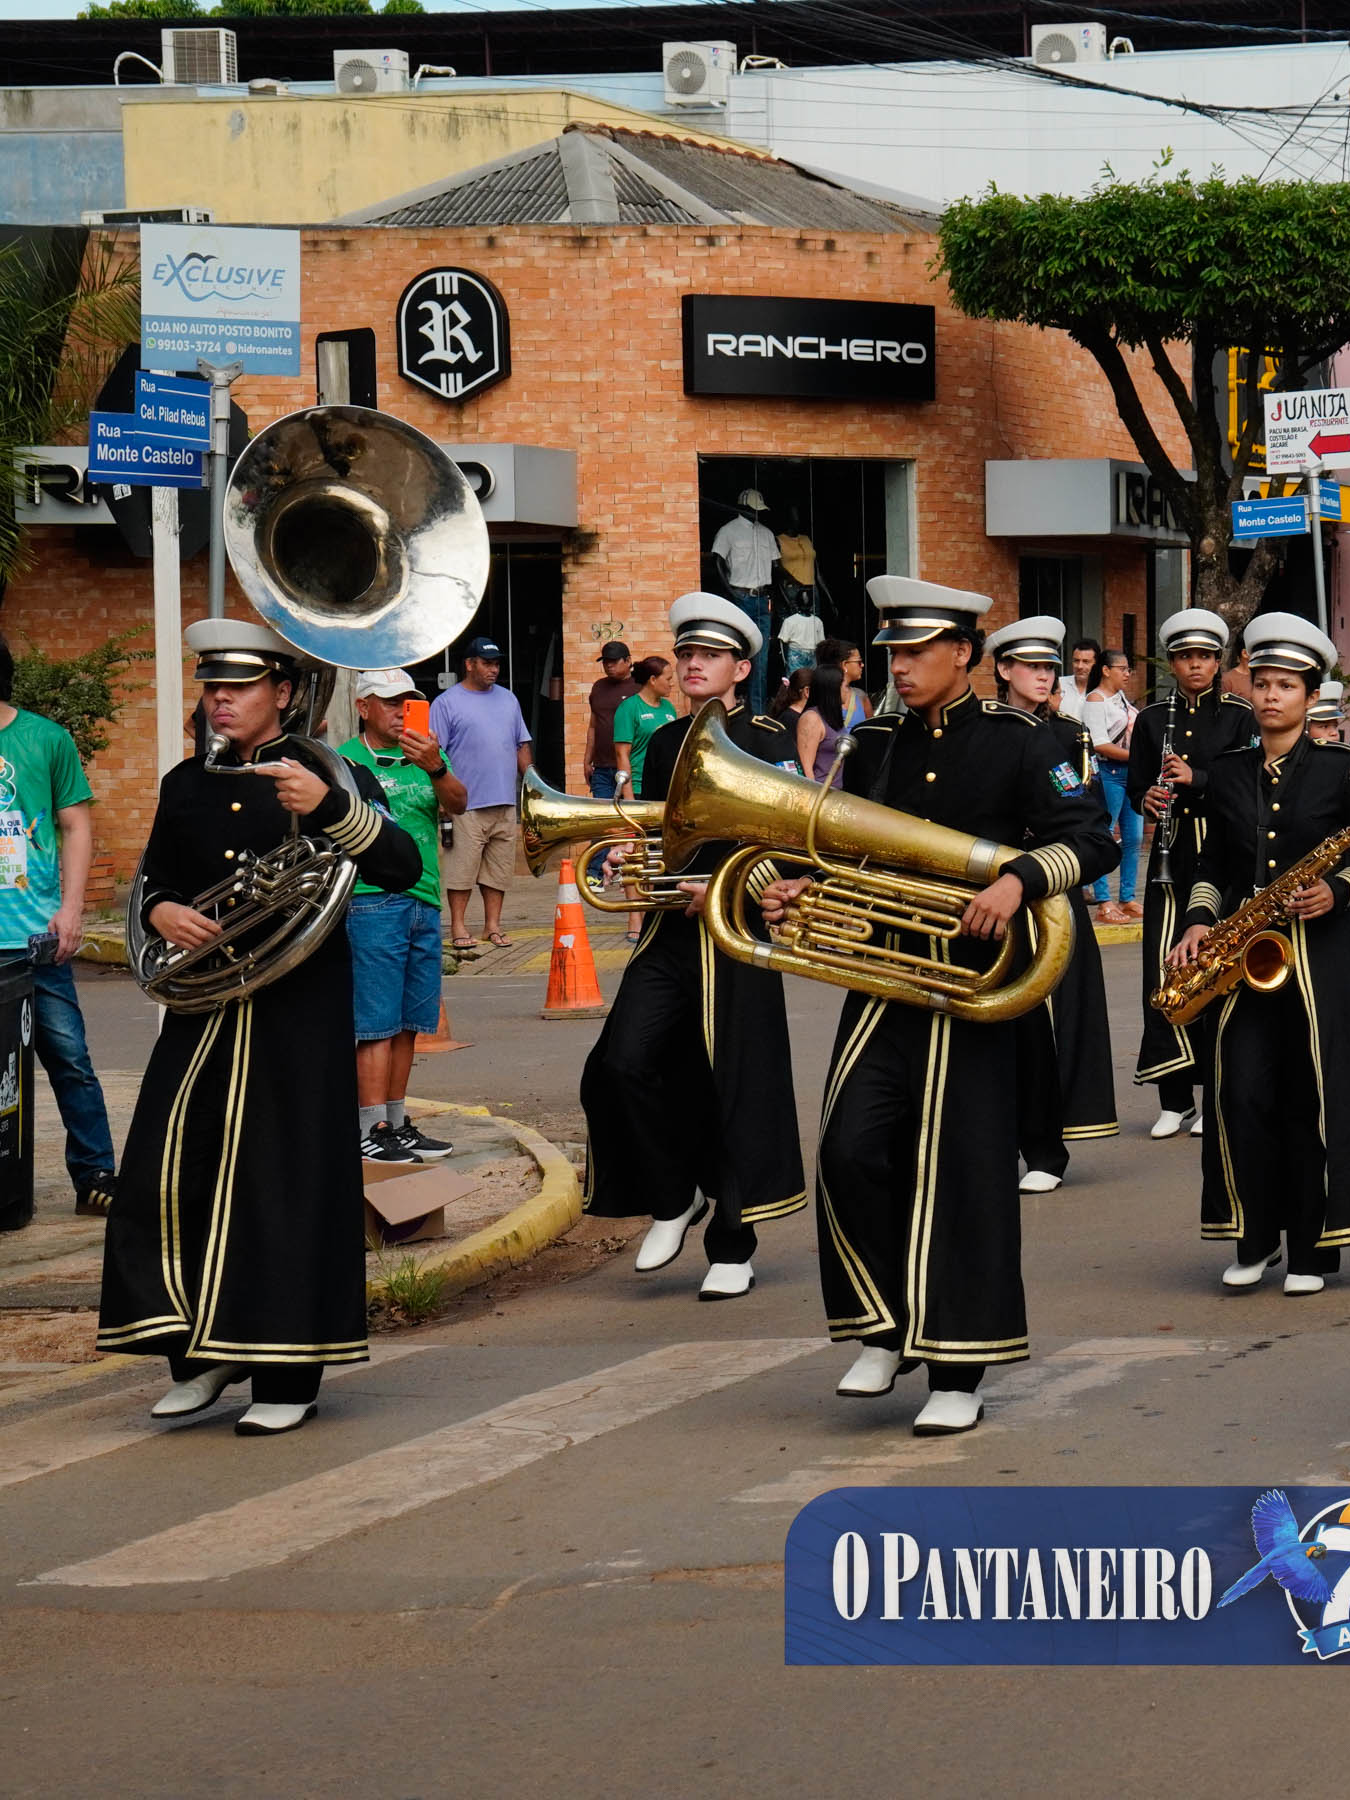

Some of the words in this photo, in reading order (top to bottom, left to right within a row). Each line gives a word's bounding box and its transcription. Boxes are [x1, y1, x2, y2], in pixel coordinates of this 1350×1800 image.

[152, 253, 286, 294] EXCLUSIVE
[145, 321, 171, 333] LOJA
[172, 323, 188, 334] NO
[189, 324, 217, 336] AUTO
[218, 325, 252, 337] POSTO
[253, 327, 292, 339] BONITO
[157, 339, 221, 353] 99103-3724
[238, 343, 293, 356] hidronantes
[707, 332, 927, 365] RANCHERO
[140, 378, 156, 393] Rua
[1271, 392, 1349, 421] JUANITA
[140, 403, 157, 420] Cel.
[158, 406, 179, 424] Pilad
[180, 409, 206, 427] Rebuá
[97, 423, 121, 438] Rua
[97, 443, 139, 462] Monte
[142, 446, 194, 465] Castelo
[1238, 504, 1252, 513] Rua
[1239, 517, 1266, 528] Monte
[1267, 514, 1302, 525] Castelo
